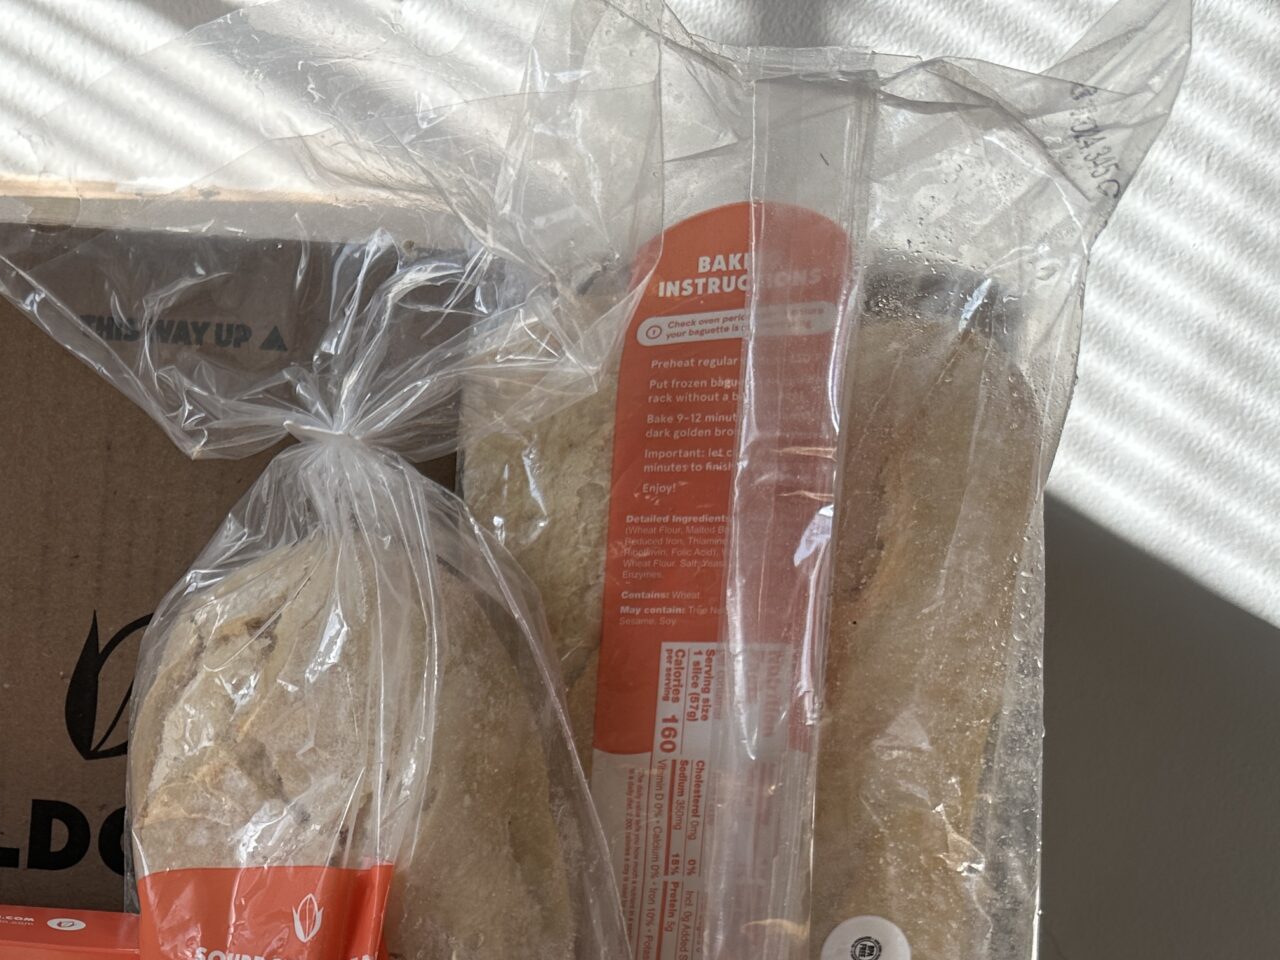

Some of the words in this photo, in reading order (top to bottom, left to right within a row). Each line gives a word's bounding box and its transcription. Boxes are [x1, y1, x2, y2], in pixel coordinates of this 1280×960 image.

[80, 314, 140, 342] THIS
[155, 319, 210, 346] WAY
[215, 323, 252, 348] UP
[651, 357, 696, 369] Preheat
[697, 355, 739, 369] regular
[649, 379, 668, 389] Put
[671, 378, 708, 388] frozen
[647, 393, 673, 403] rack
[675, 391, 720, 403] without
[721, 394, 729, 402] a
[646, 413, 674, 424] Bake
[676, 412, 702, 423] 9-12
[645, 428, 671, 438] dark
[673, 427, 712, 440] golden
[644, 448, 705, 460] Important:
[643, 462, 689, 473] minutes
[690, 462, 703, 472] to
[642, 482, 677, 495] Enjoy!
[626, 514, 670, 523] Detailed
[621, 590, 670, 599] Contains:
[619, 605, 642, 616] May
[643, 605, 686, 614] contain:
[665, 648, 674, 665] per
[671, 648, 686, 704] Calories
[691, 660, 703, 689] slice
[701, 649, 716, 694] Serving
[661, 666, 672, 702] serving
[686, 692, 701, 722] (57g)
[700, 697, 712, 722] size
[659, 714, 679, 754] 160
[677, 759, 689, 797] Sodium
[691, 760, 705, 818] Cholesterol
[670, 853, 680, 876] 15%
[686, 859, 697, 876] 0%
